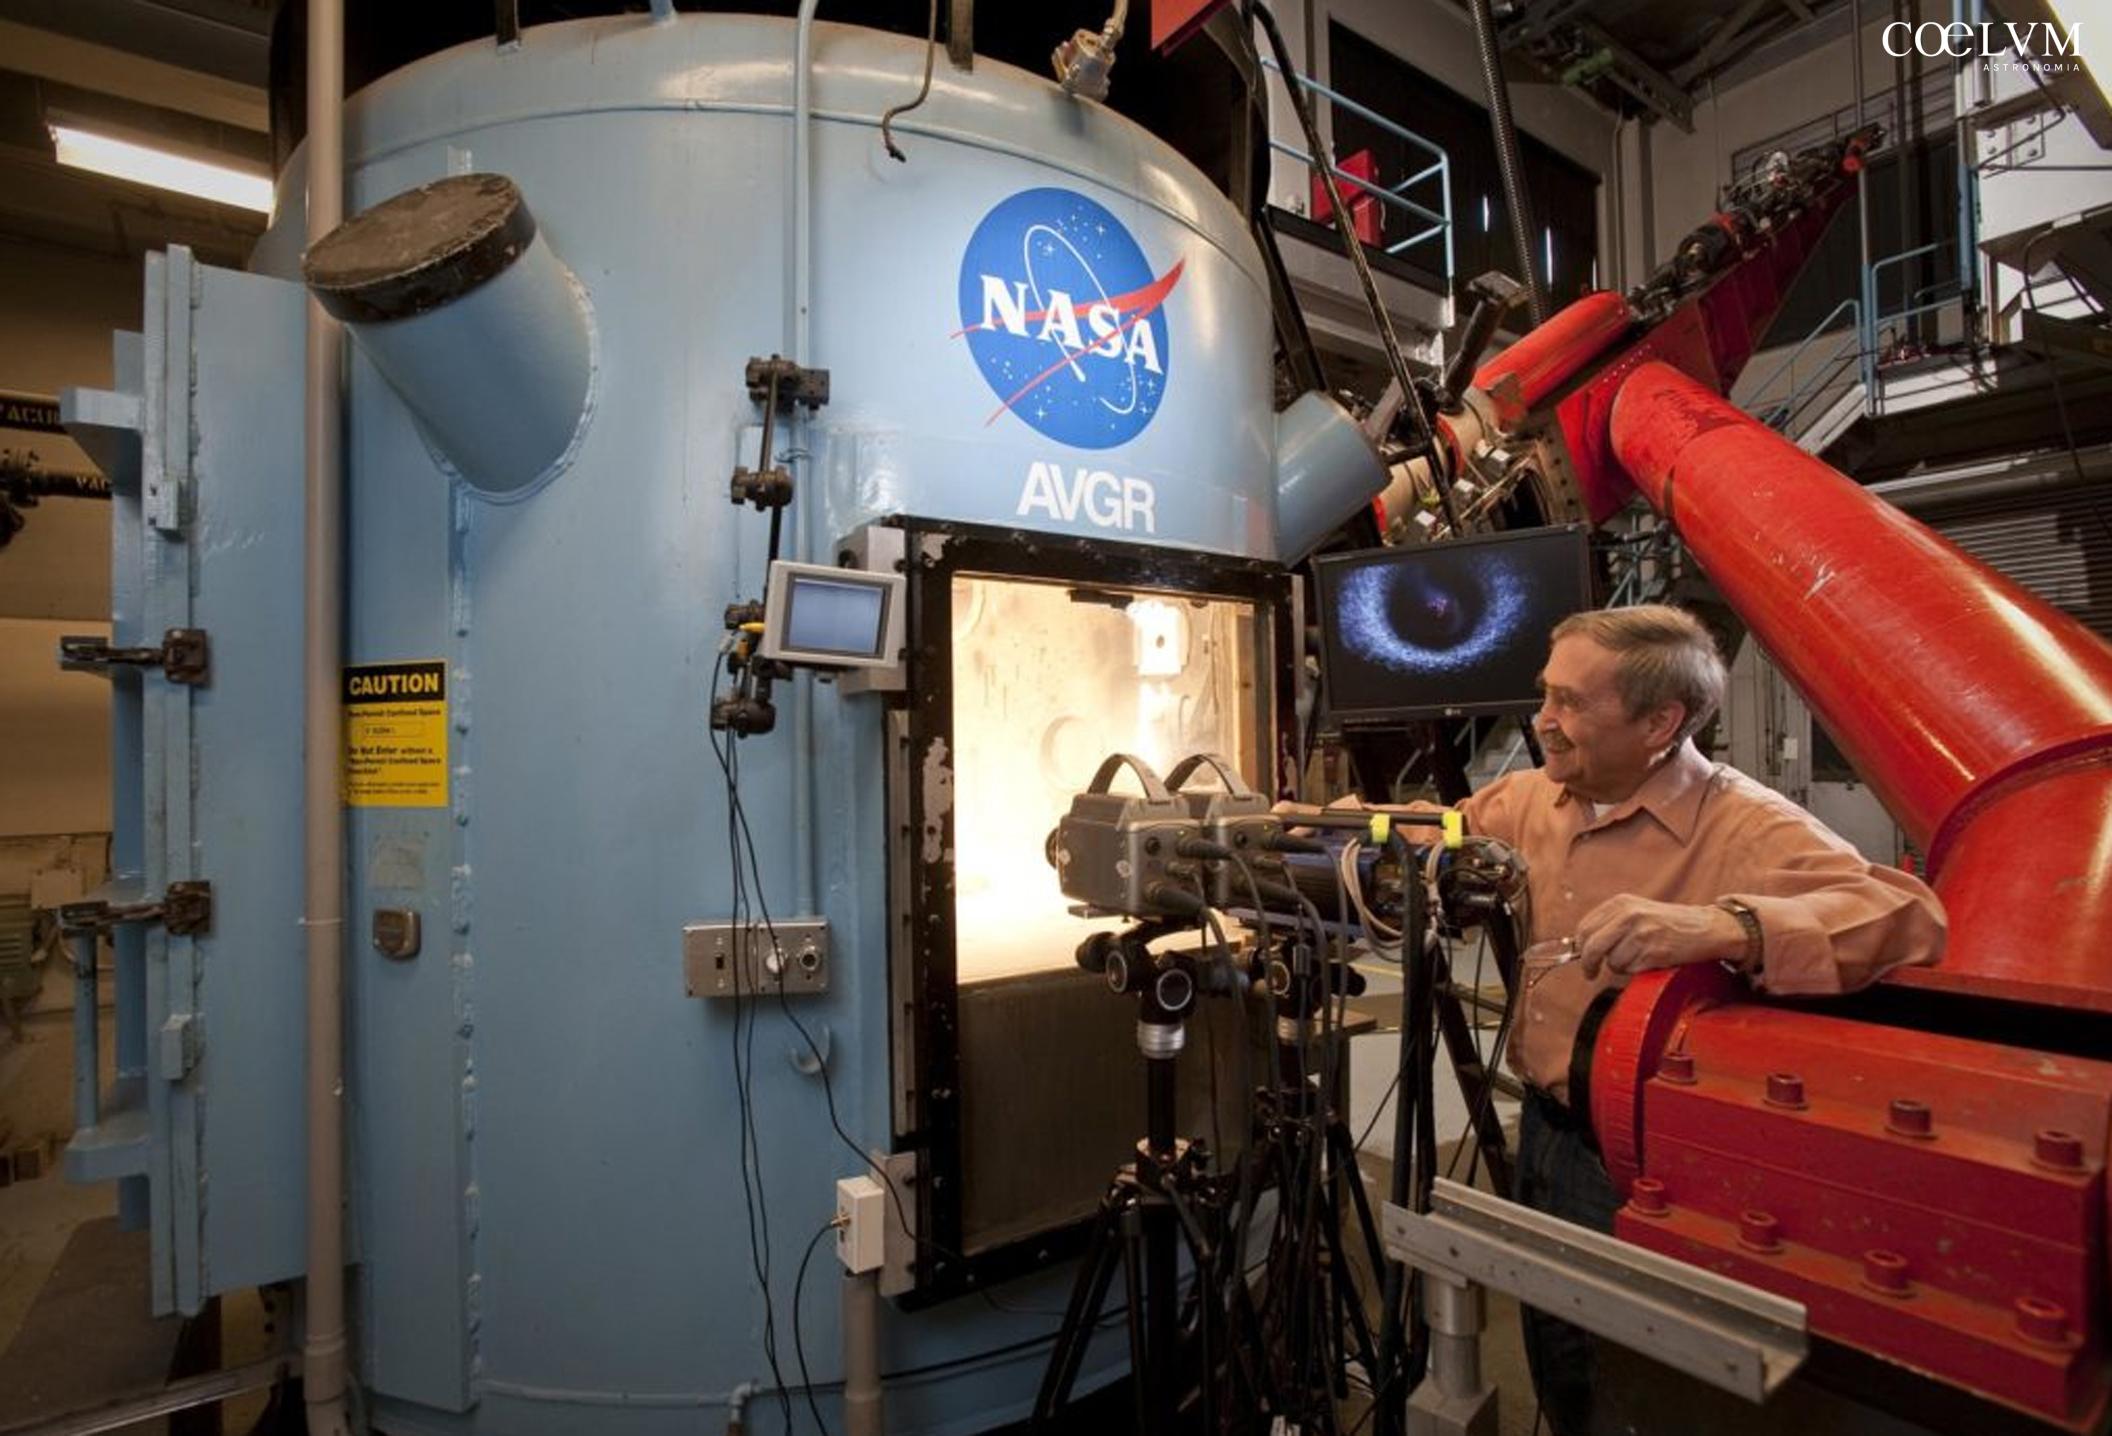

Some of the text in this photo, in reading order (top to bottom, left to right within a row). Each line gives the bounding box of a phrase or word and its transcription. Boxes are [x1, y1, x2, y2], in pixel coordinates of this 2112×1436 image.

[980, 274, 1163, 375] NASA
[1016, 461, 1155, 534] AVGR
[349, 672, 440, 696] CAUTION
